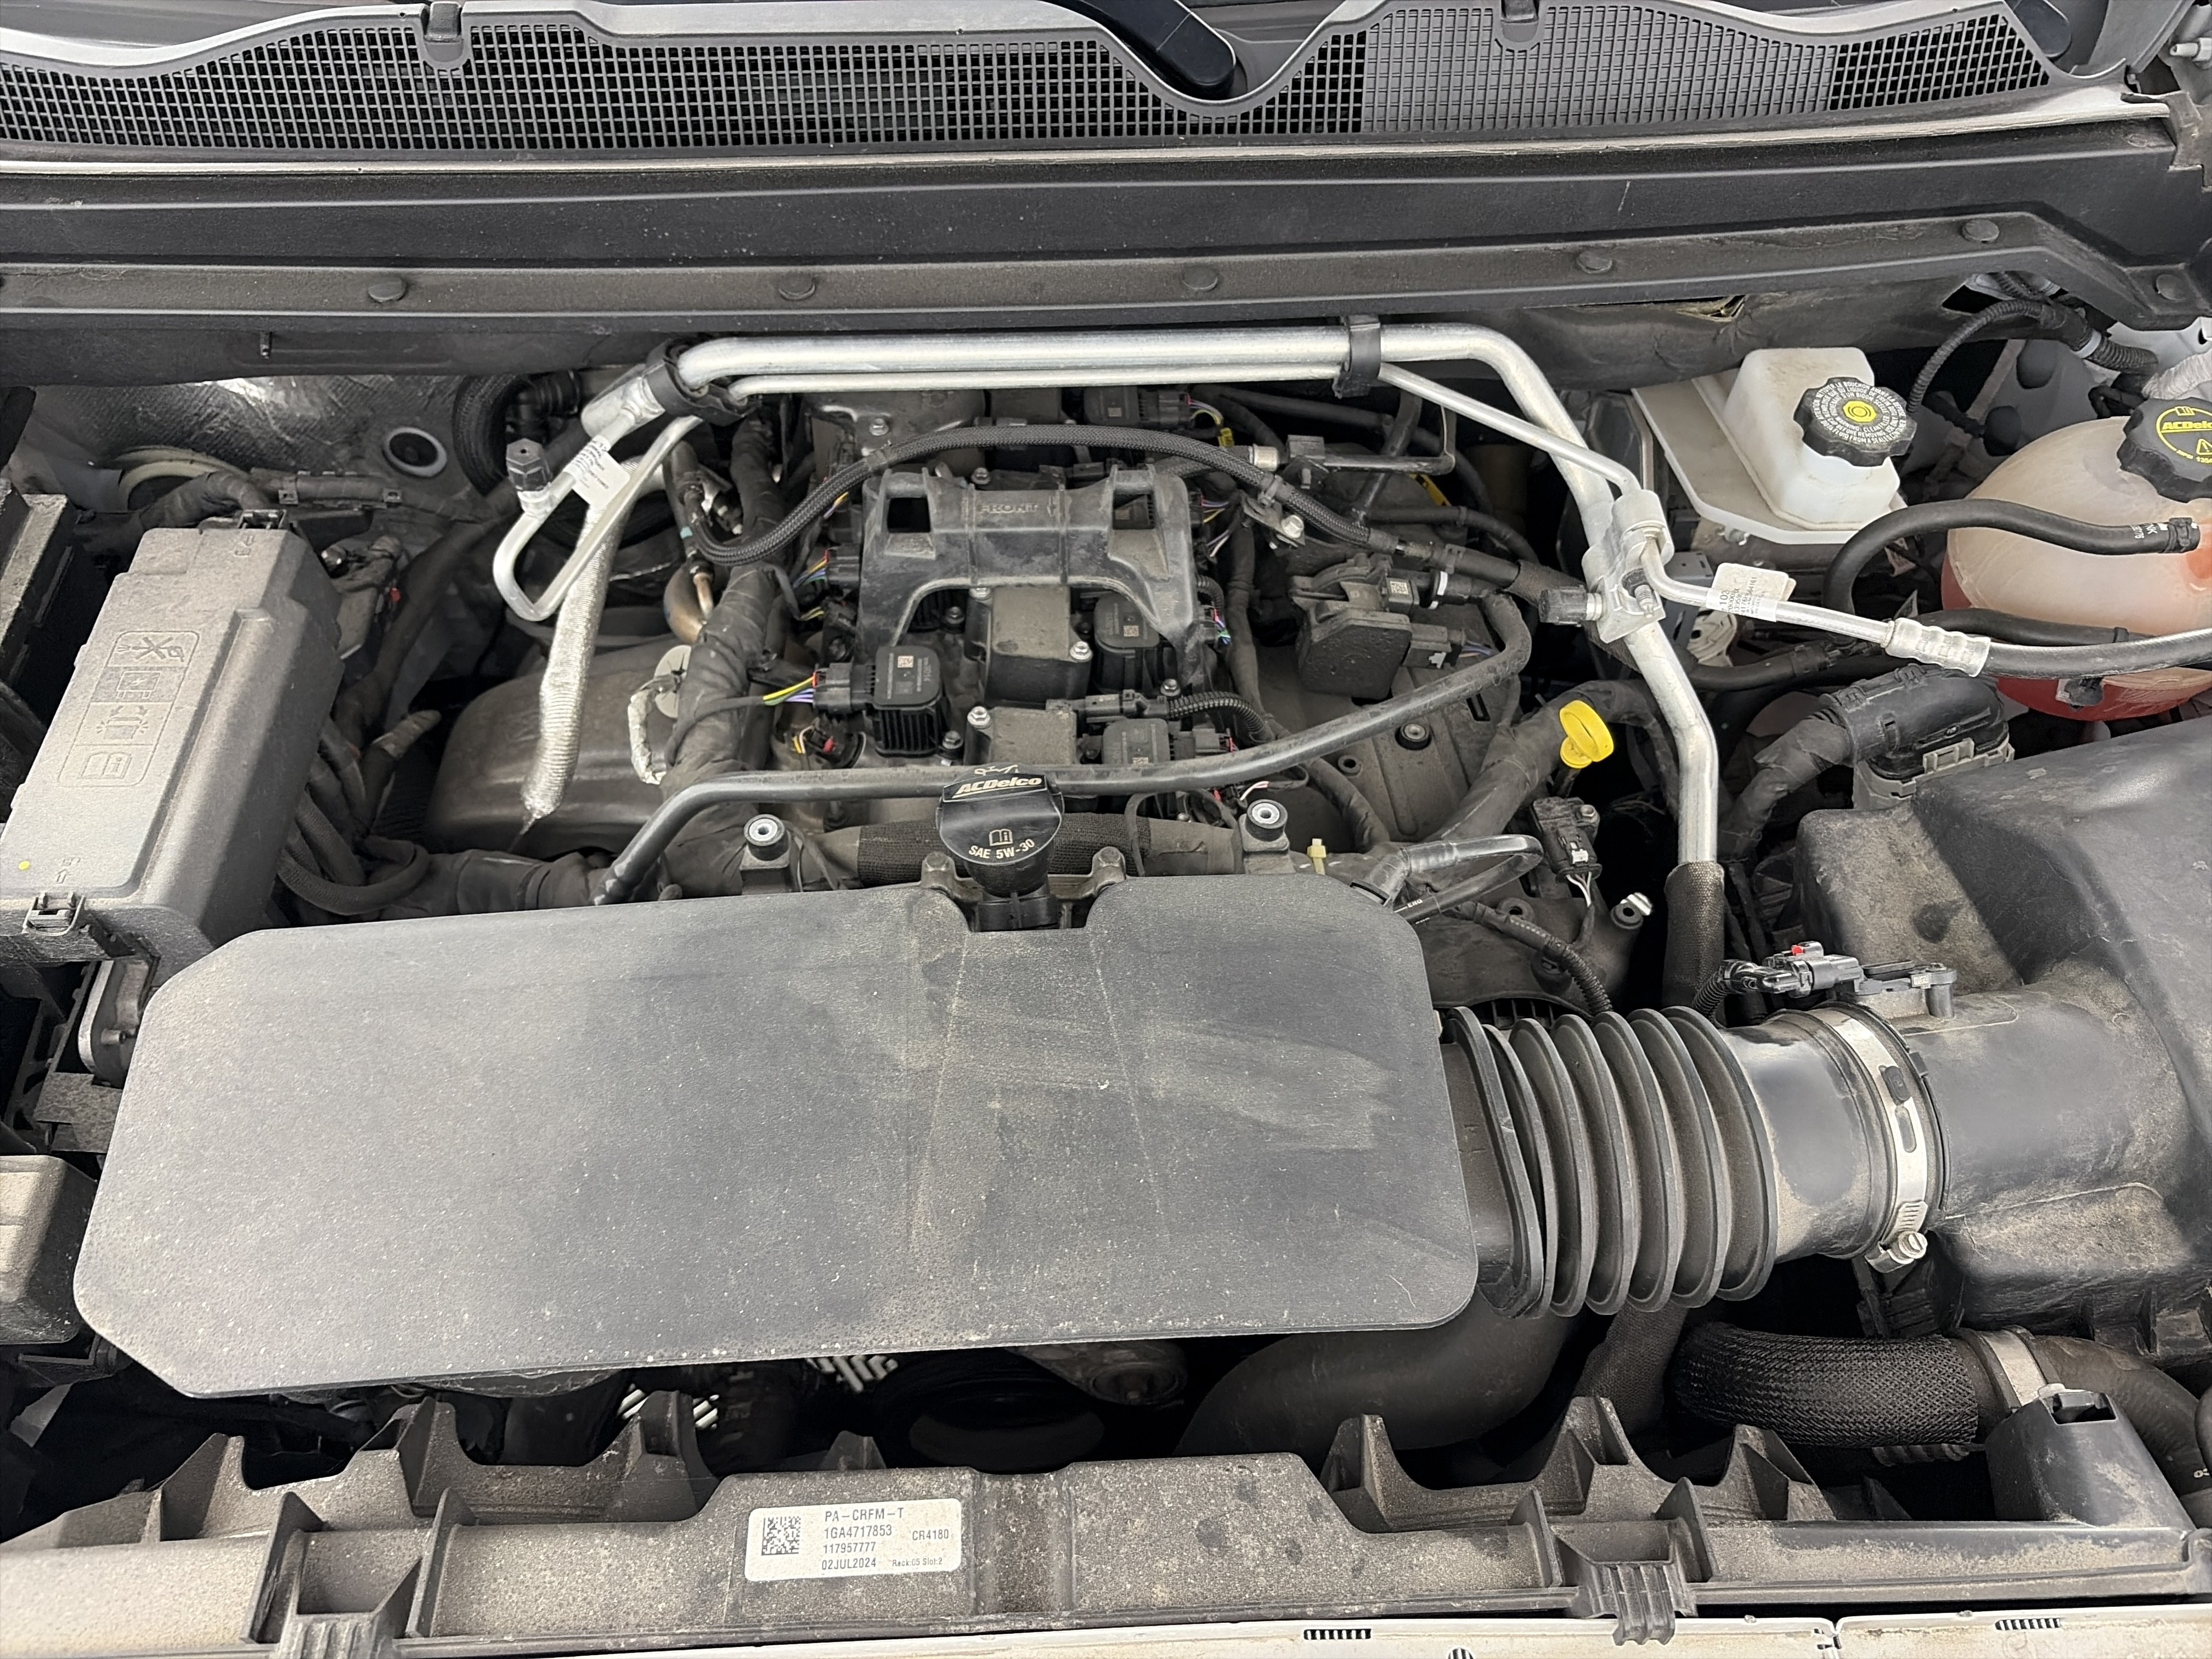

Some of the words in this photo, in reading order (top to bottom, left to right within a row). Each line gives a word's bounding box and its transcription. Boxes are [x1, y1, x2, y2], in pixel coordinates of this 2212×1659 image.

[1843, 381, 1870, 390] BOUCHON
[1870, 387, 1888, 397] AVANT
[1856, 392, 1874, 401] BIDON
[1876, 395, 1892, 406] FREIN
[1832, 428, 1849, 439] FLUID
[1849, 434, 1866, 443] FROM
[1871, 435, 1892, 444] SEALED
[1836, 424, 1858, 437] BEFORE
[955, 777, 1042, 794] ACDelco
[969, 845, 991, 859] SAE
[996, 839, 1035, 859] 5W-30
[824, 1524, 892, 1539] 1GA4717853
[912, 1529, 949, 1541] CR4180
[823, 1542, 876, 1554] 117957777
[822, 1557, 876, 1570] 02JUL2024
[892, 1558, 920, 1567] Rack:05
[922, 1557, 943, 1566] Slot:2
